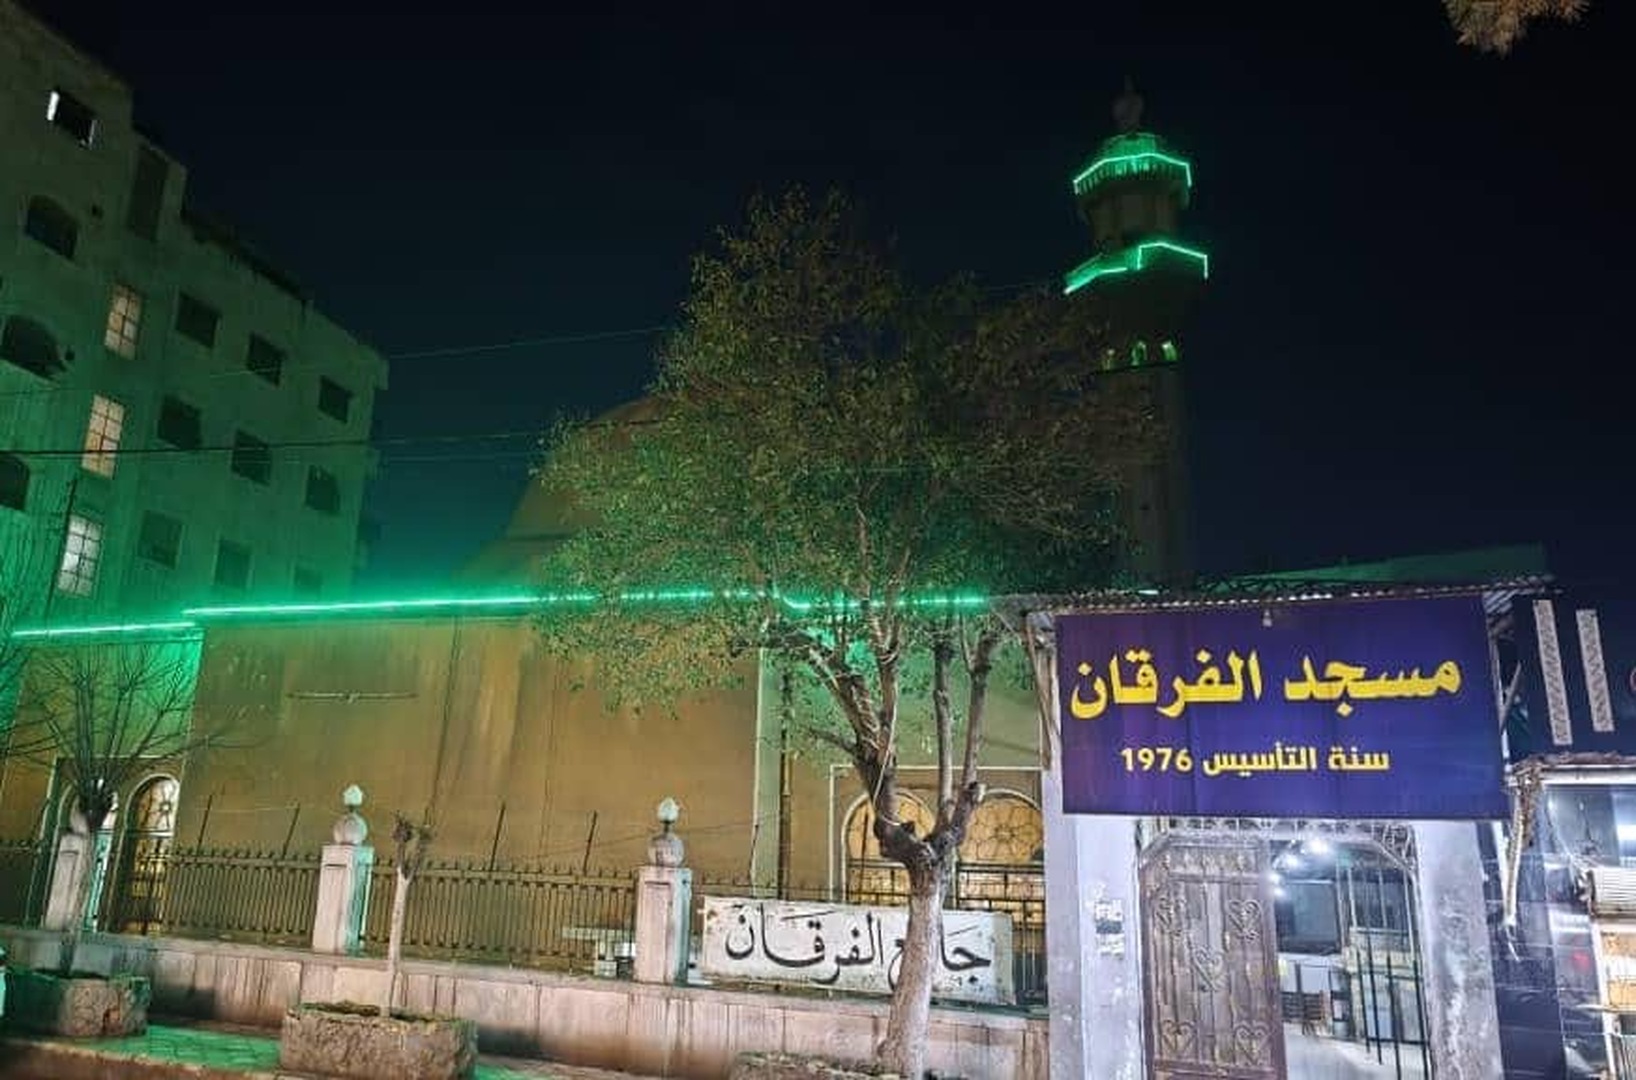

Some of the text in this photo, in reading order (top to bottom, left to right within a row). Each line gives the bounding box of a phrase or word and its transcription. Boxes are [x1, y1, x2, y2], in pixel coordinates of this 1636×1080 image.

[1070, 649, 1462, 719] مسجد الفرقان
[1121, 741, 1390, 776] سنة التأسيس 1976
[725, 902, 992, 992] جاع الفرقان
